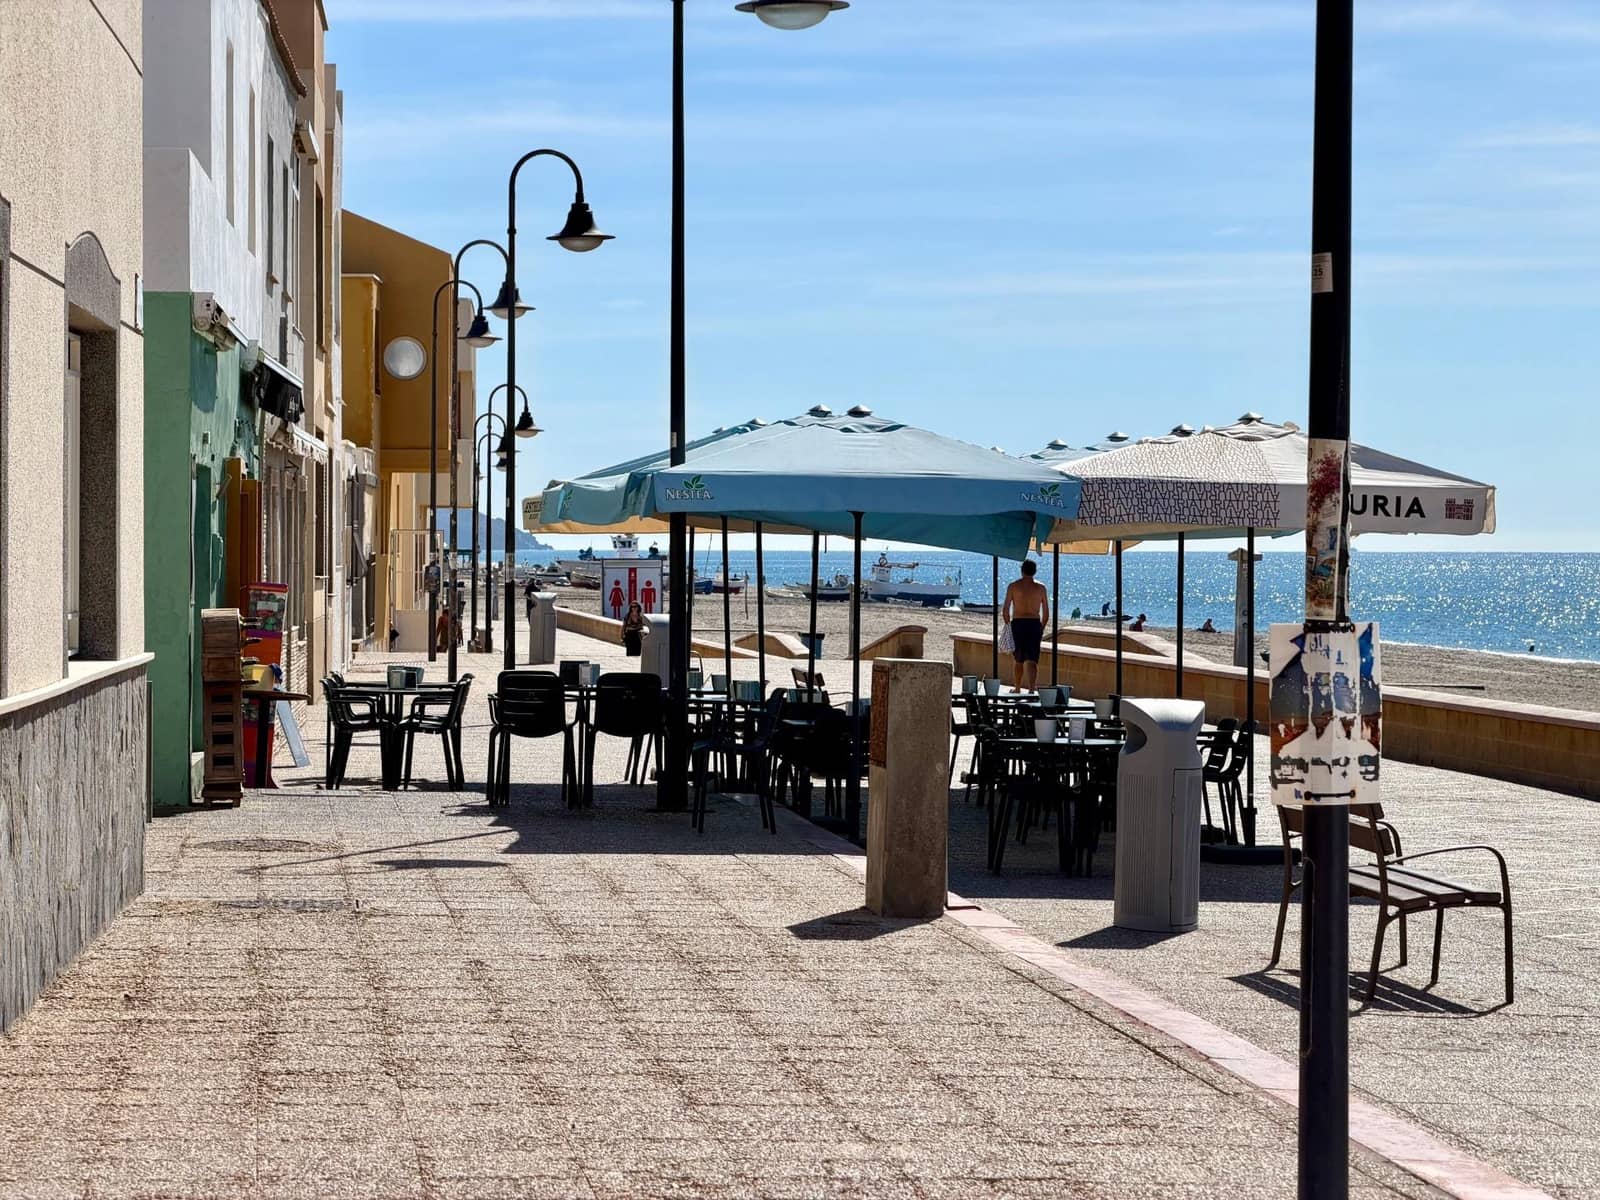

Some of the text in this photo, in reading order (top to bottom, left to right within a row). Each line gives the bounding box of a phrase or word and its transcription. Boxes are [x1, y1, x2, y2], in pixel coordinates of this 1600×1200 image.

[666, 488, 712, 501] NESTEA
[1020, 492, 1066, 509] NESTEA
[1350, 494, 1426, 519] URIA
